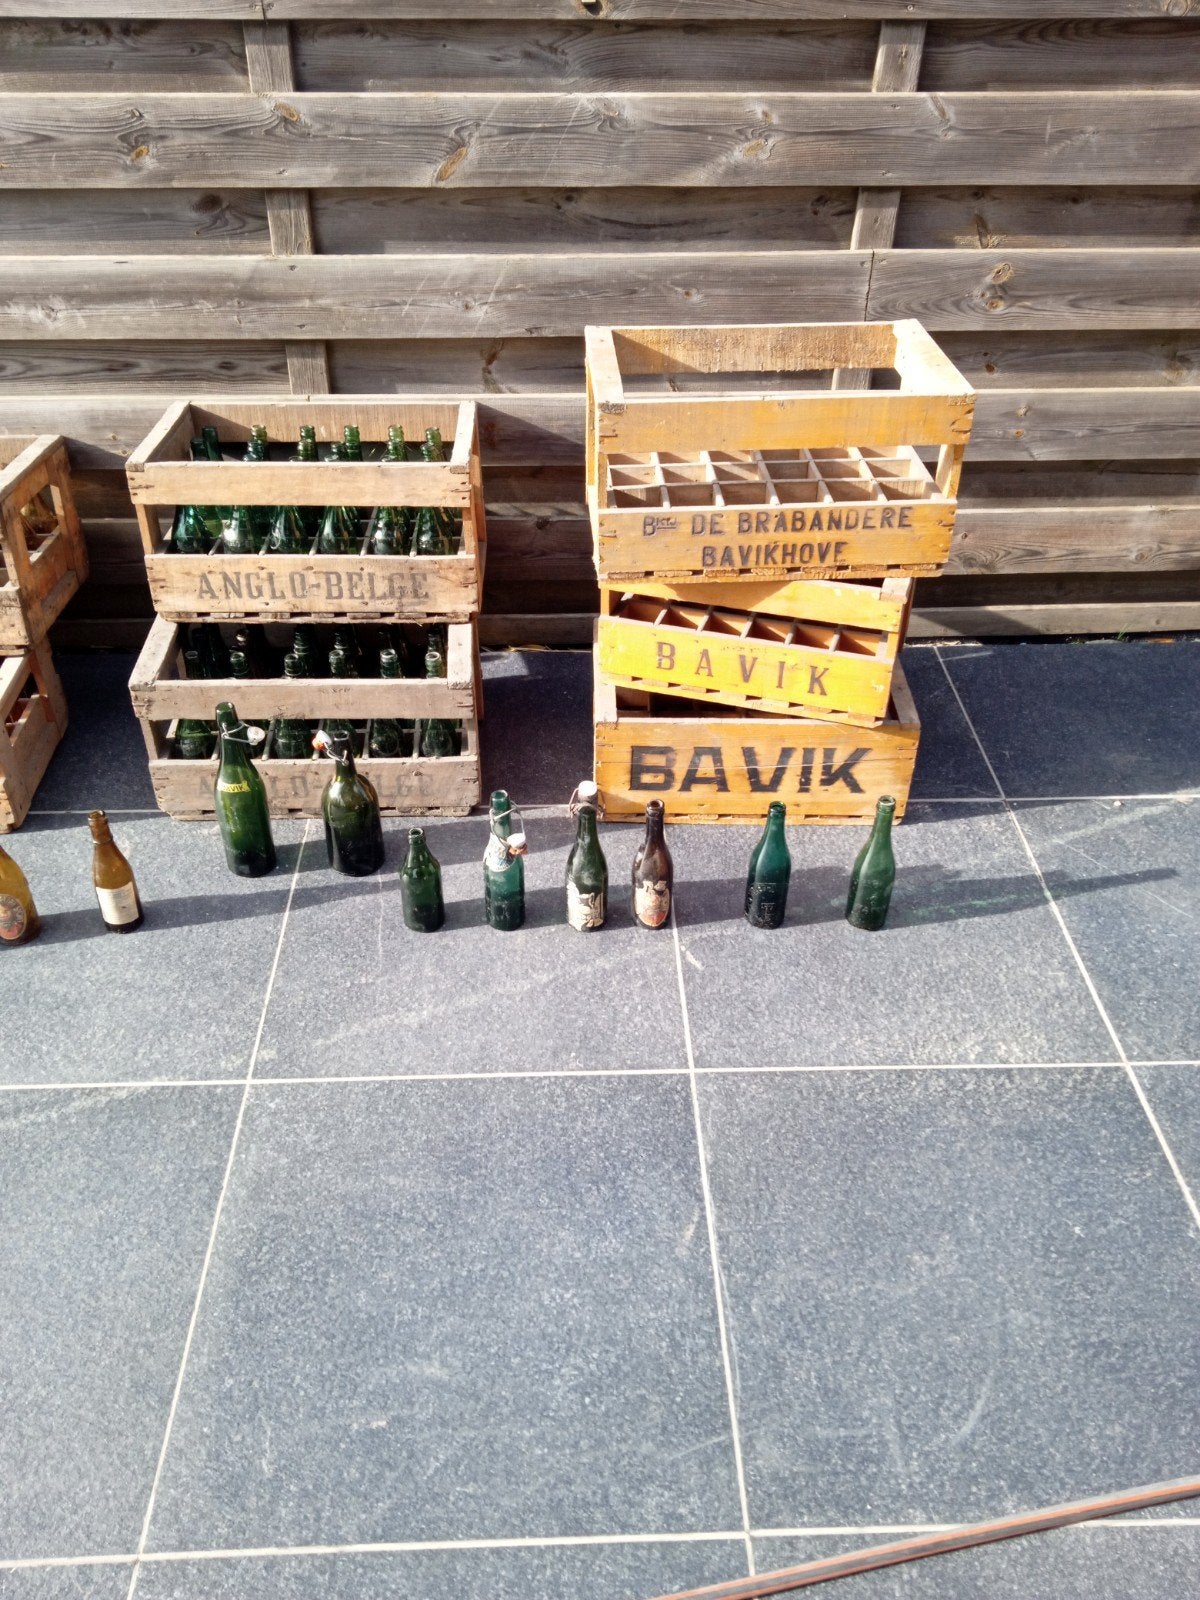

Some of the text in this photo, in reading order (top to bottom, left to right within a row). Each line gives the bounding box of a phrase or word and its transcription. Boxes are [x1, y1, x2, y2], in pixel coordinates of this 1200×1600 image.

[691, 512, 724, 536] DE
[738, 506, 913, 534] BRABANDERE
[702, 541, 848, 567] BAVIKHOVE
[199, 571, 429, 600] ANGLO-BELGE
[656, 641, 830, 696] BAVIK
[629, 745, 873, 794] BAVIK
